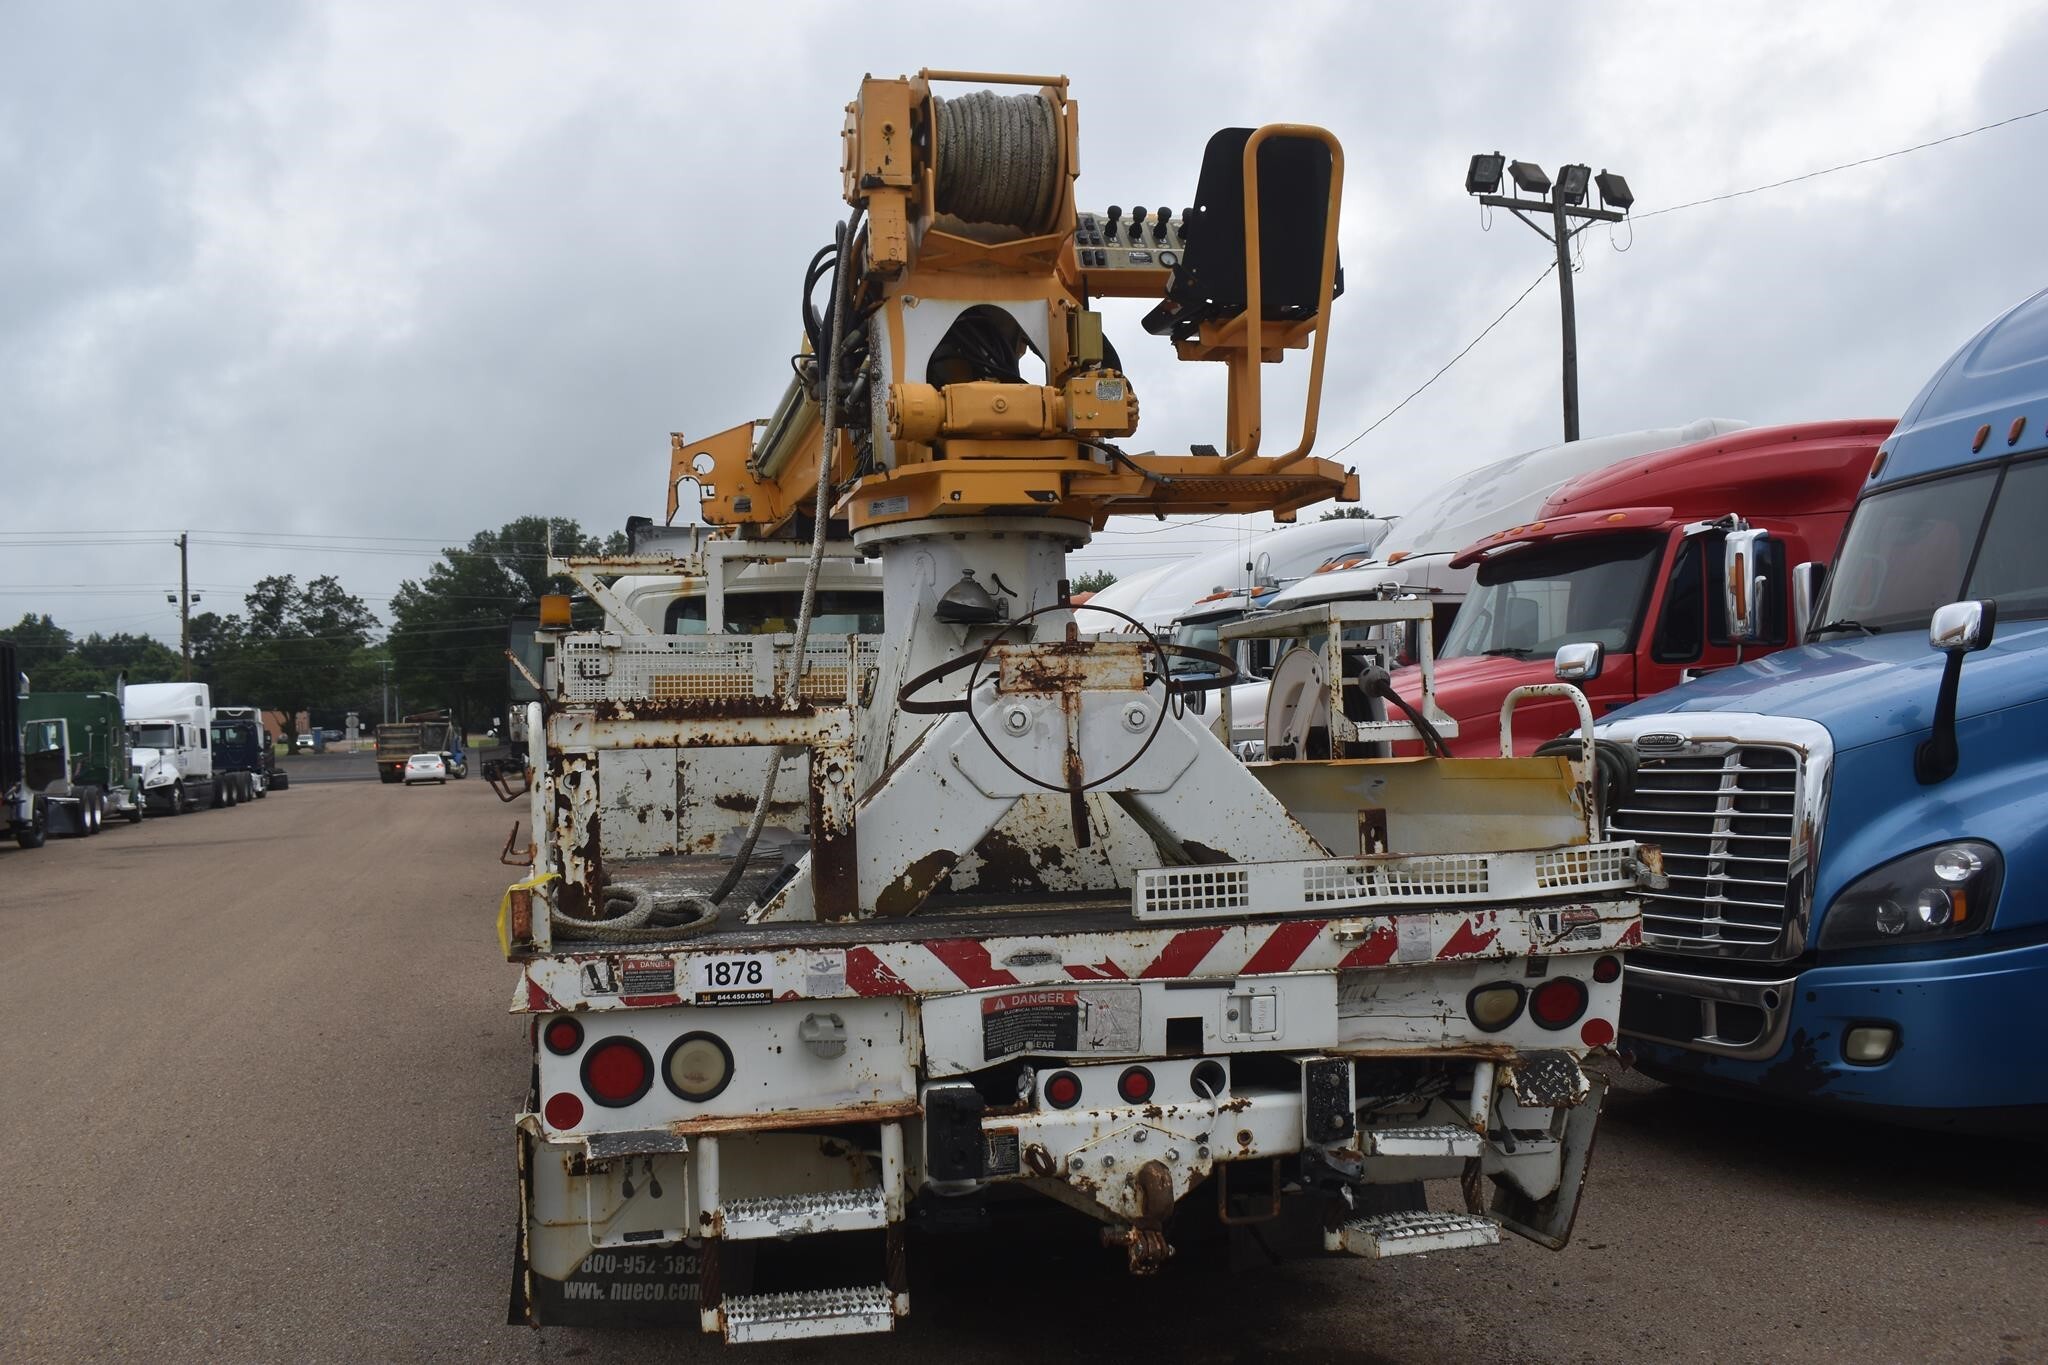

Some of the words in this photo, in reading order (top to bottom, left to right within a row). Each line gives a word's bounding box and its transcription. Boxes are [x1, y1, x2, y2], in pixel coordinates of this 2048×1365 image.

[704, 960, 763, 986] 1878
[717, 992, 765, 1001] 844.450.6200
[1011, 992, 1065, 1006] DANGER
[1004, 1042, 1024, 1054] KEEP
